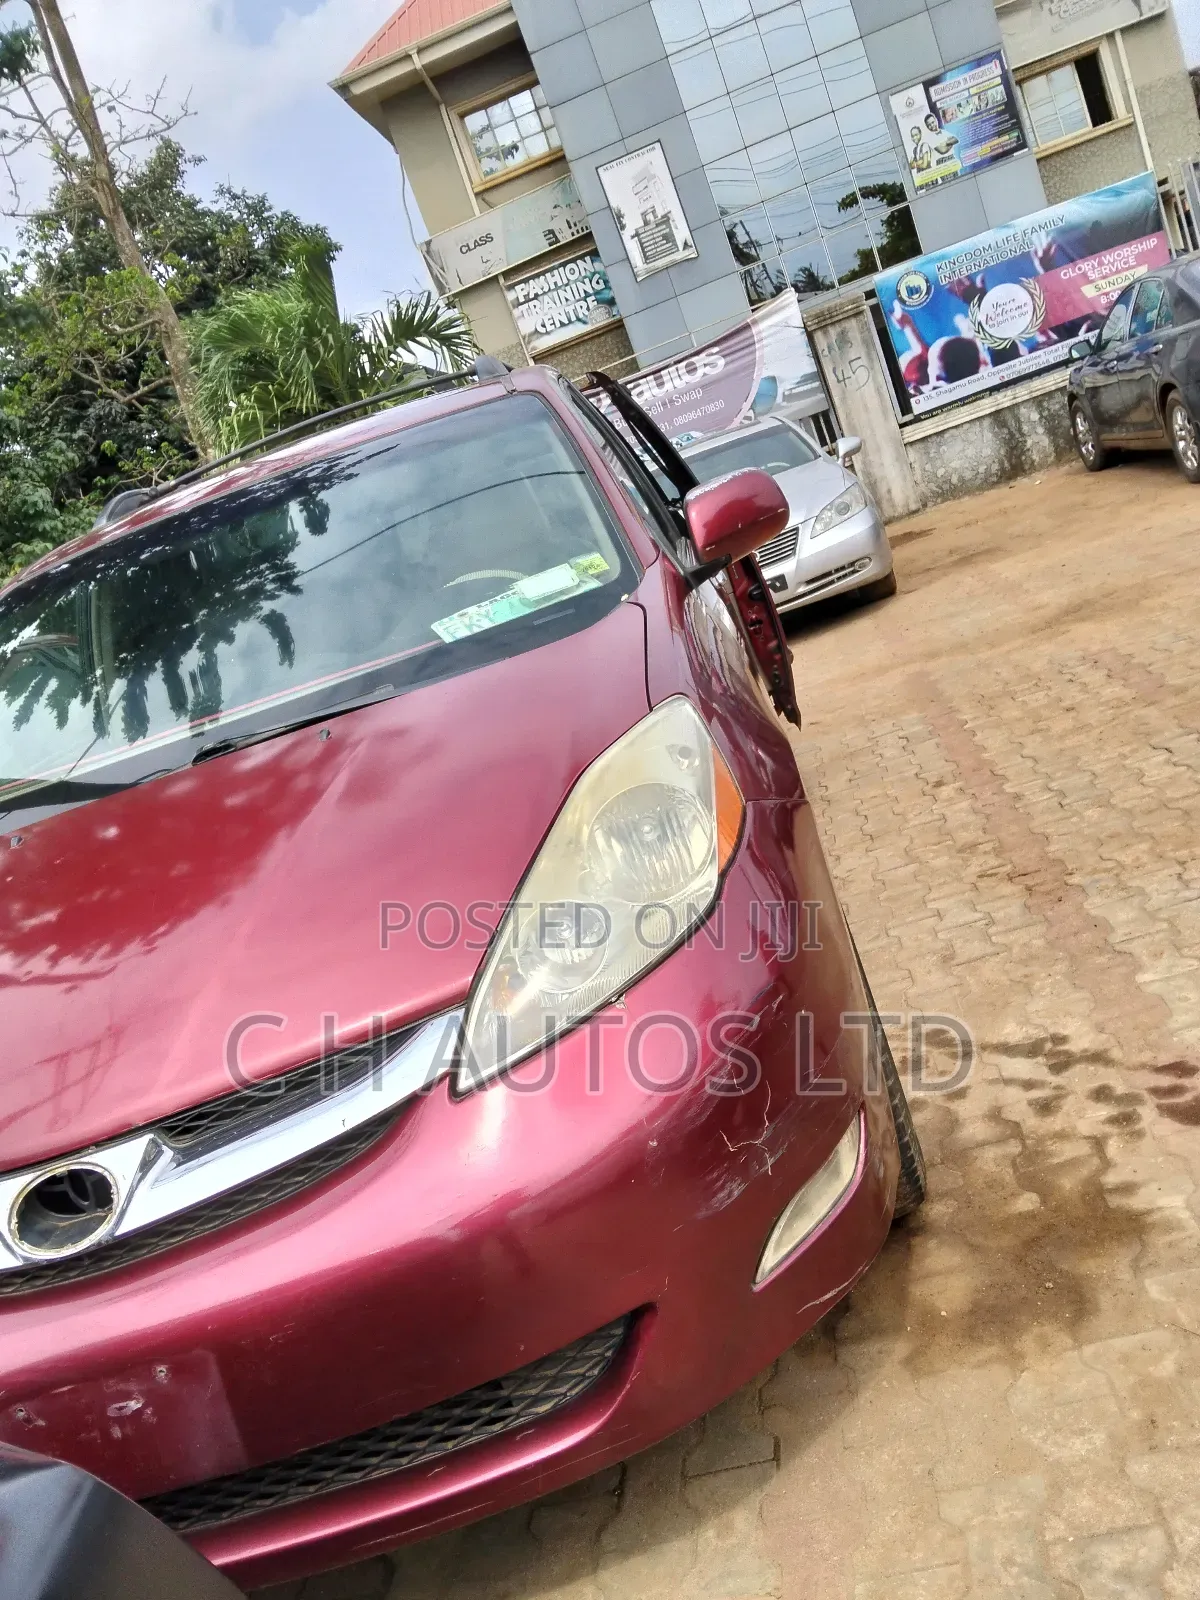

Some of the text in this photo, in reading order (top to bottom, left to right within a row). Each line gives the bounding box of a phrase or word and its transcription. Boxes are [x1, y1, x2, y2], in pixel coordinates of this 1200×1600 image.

[459, 232, 494, 255] CLASS
[936, 215, 1066, 273] KINGDOM LIFE FAMILY
[939, 241, 1034, 285] INTERNATIONAL
[1060, 238, 1158, 280] GLORY WORSHIP
[1087, 255, 1137, 280] SERVICE
[1094, 271, 1137, 293] SUNDAY
[517, 274, 605, 320] TRAINING
[672, 388, 703, 406] Swap
[673, 399, 725, 426] 08096470830
